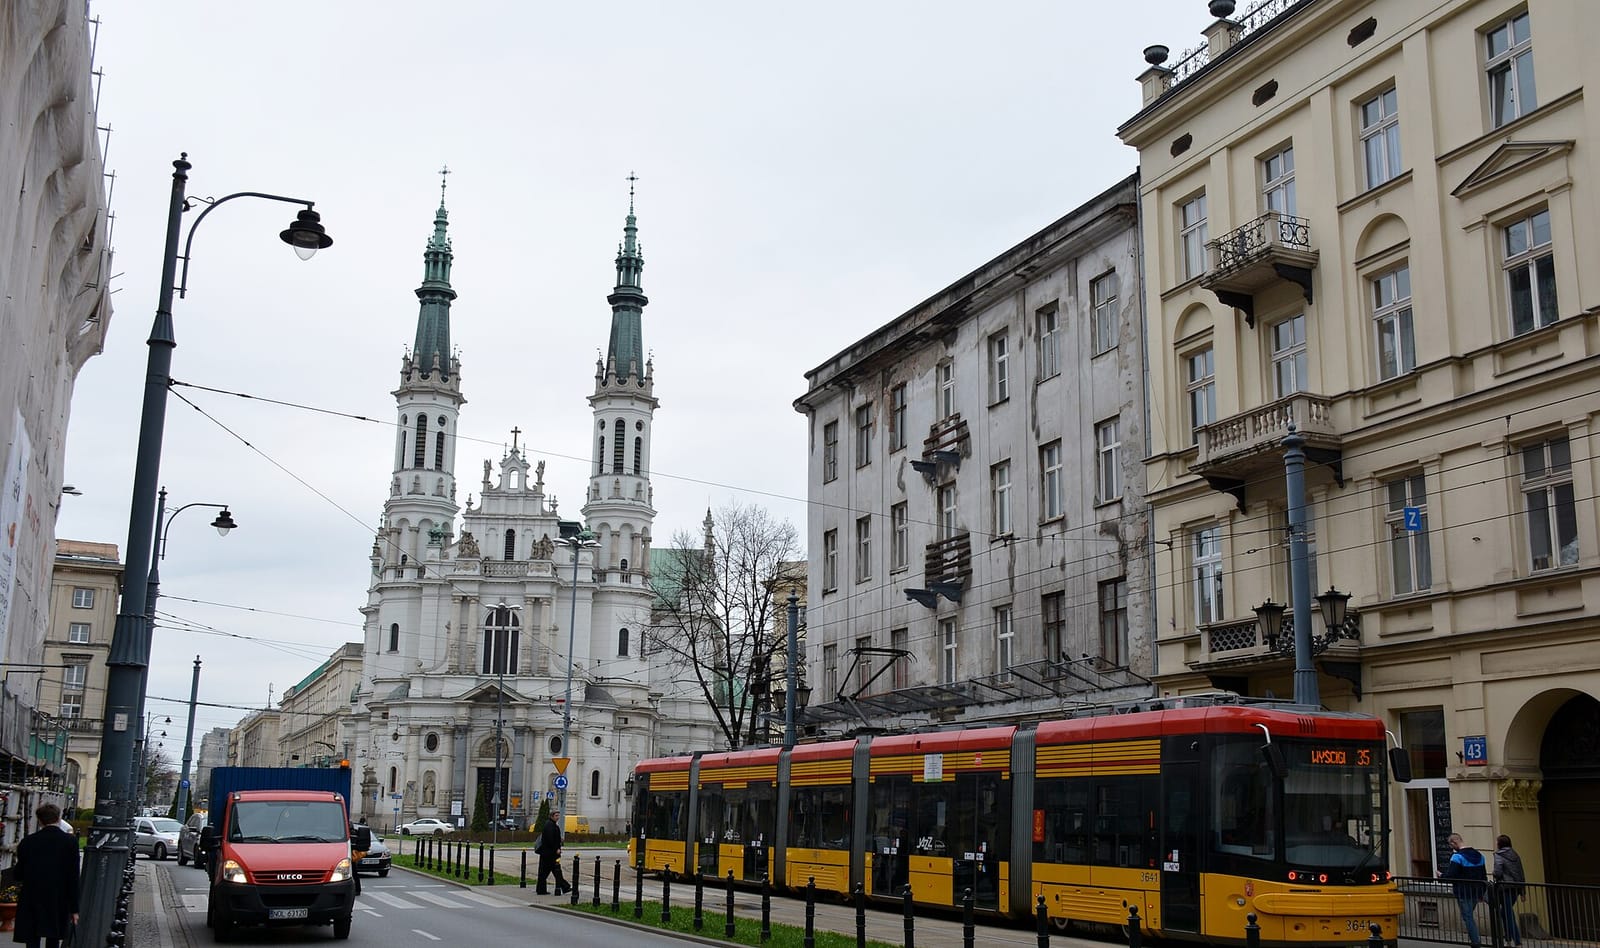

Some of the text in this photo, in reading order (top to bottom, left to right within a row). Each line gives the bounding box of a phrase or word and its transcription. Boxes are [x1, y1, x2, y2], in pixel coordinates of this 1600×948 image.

[1408, 512, 1417, 527] Z
[1356, 750, 1370, 766] 35
[1467, 743, 1482, 759] 43
[1140, 871, 1158, 882] 3641
[1345, 919, 1371, 931] 3641
